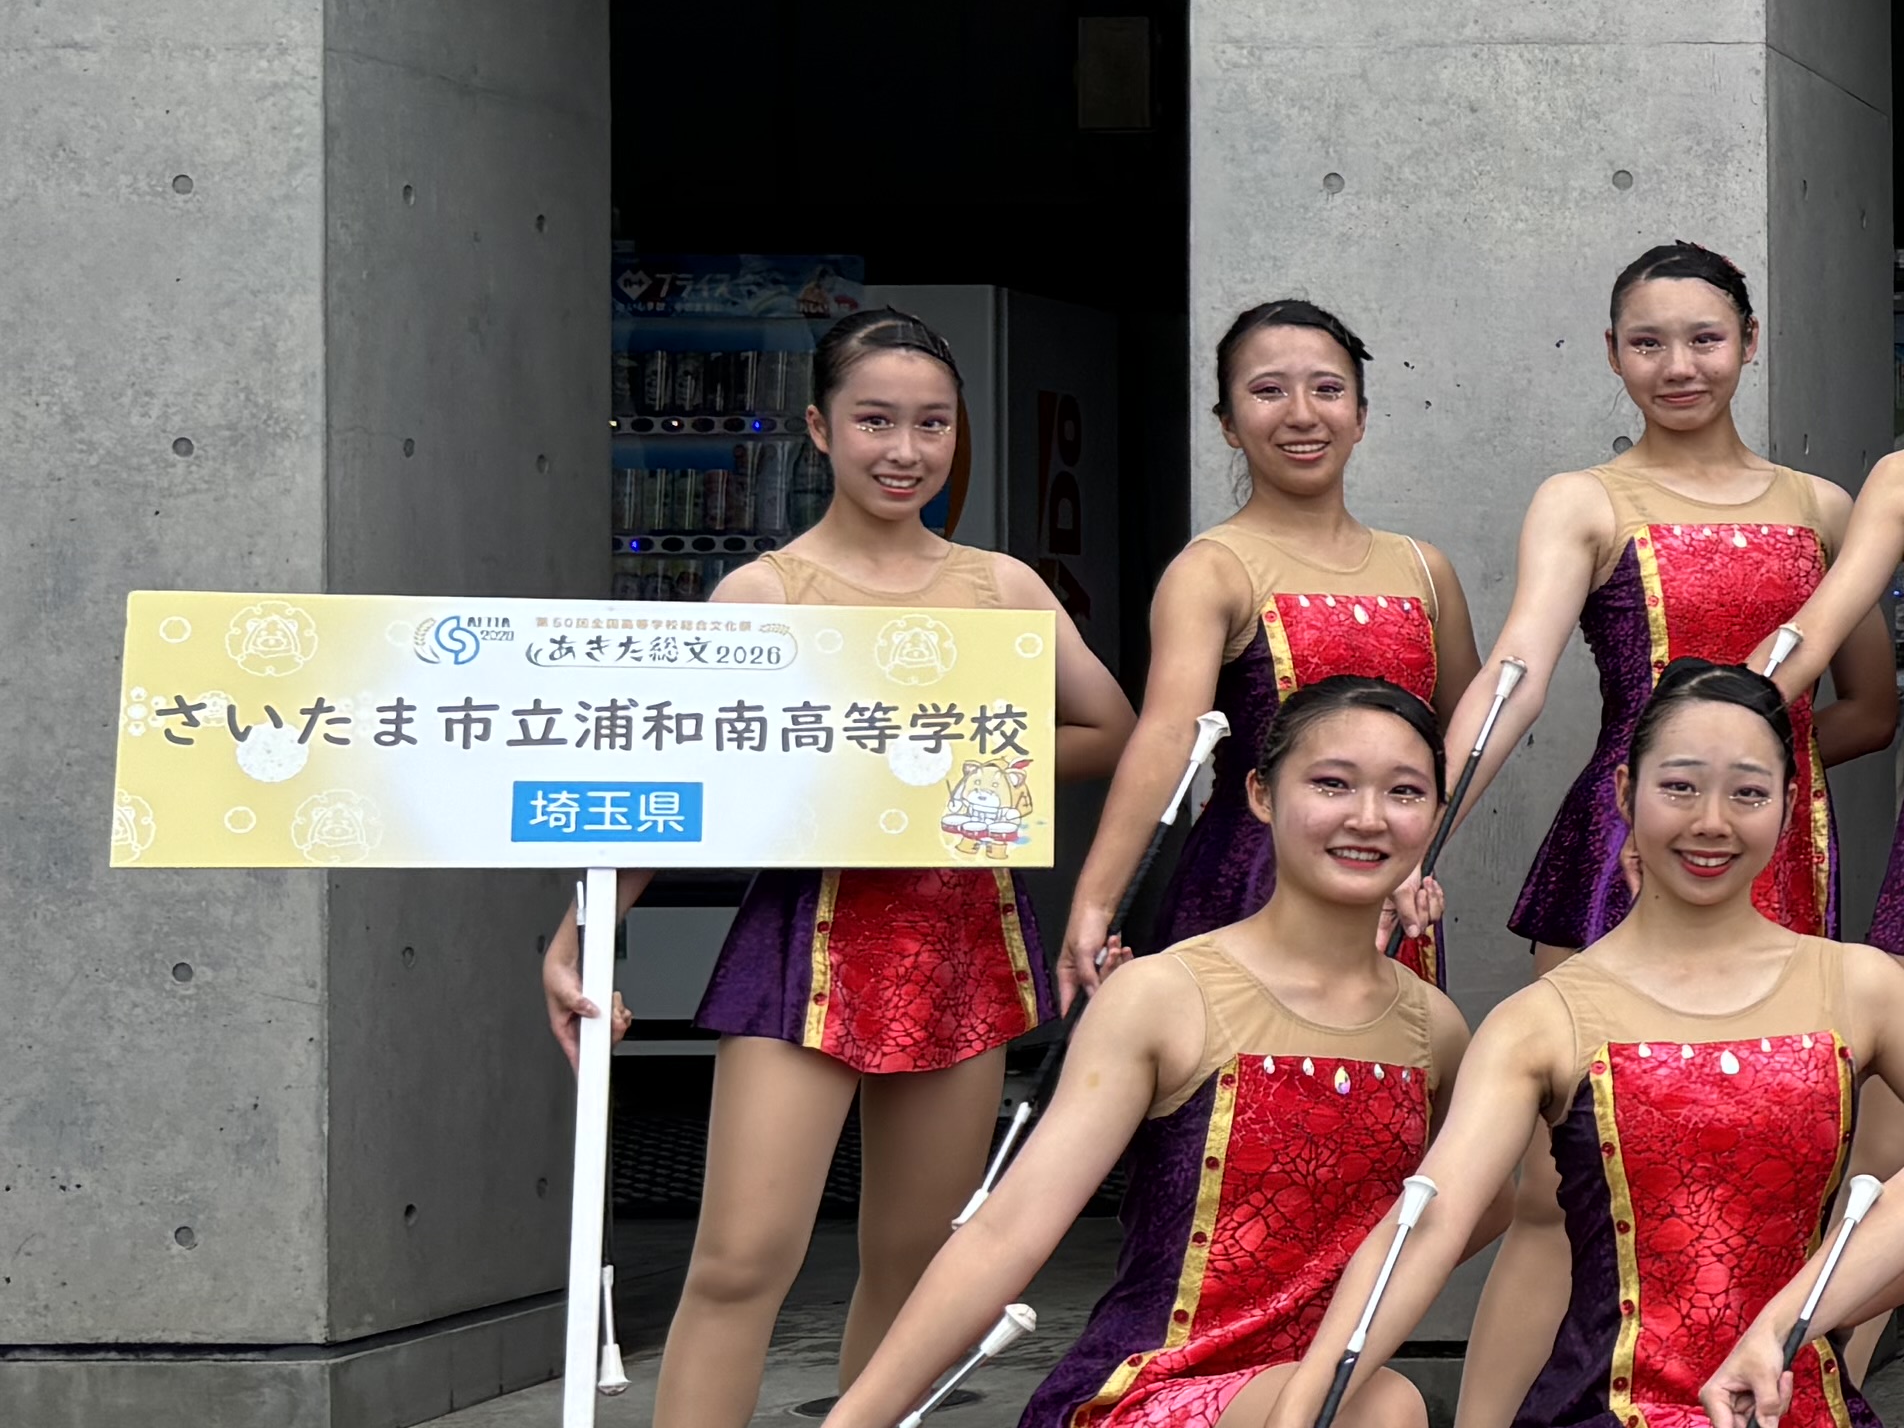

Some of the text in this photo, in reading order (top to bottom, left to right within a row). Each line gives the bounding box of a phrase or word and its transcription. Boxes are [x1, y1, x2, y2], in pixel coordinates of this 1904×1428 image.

[548, 635, 782, 664] あきた総文2026
[154, 693, 1030, 756] さいたま市立浦和南高等学校
[529, 789, 686, 833] 埼玉県
